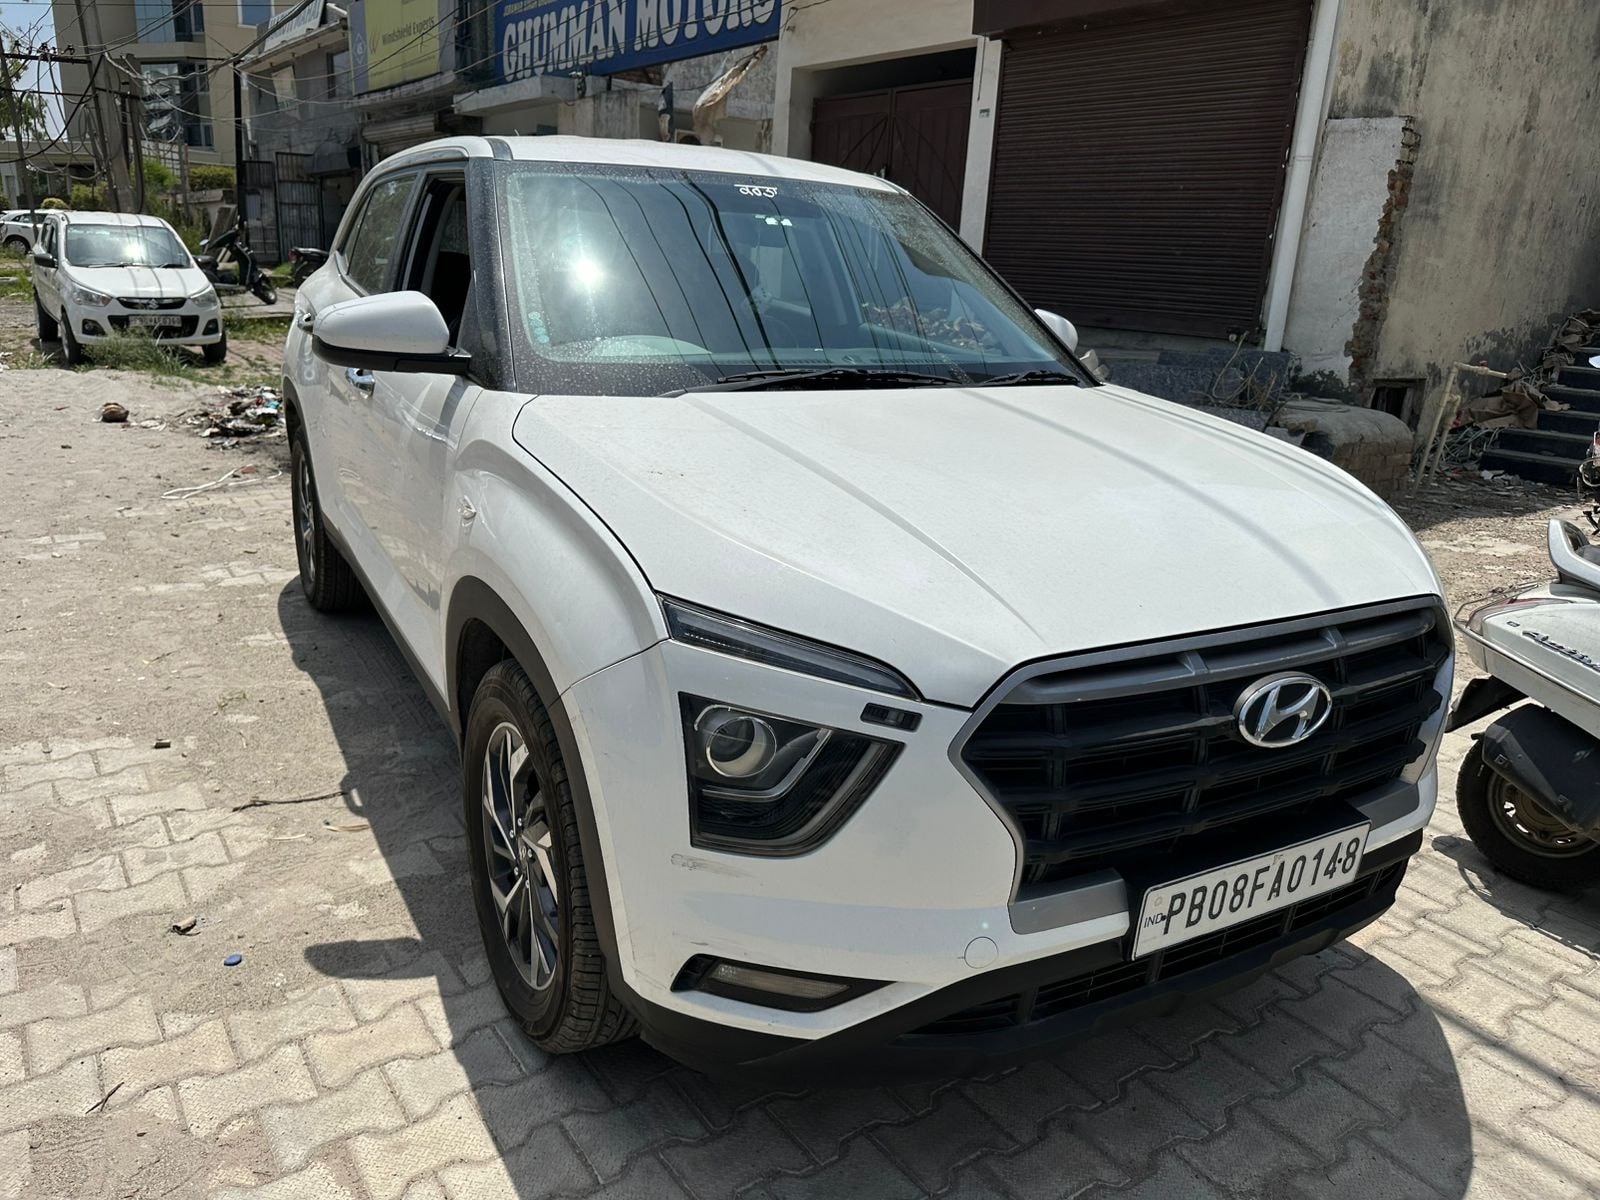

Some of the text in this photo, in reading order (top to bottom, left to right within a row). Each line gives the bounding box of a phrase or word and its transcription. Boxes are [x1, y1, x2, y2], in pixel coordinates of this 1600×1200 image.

[502, 0, 627, 83] GHUMMAN
[1143, 912, 1164, 929] IND
[1163, 837, 1361, 936] PB08FA0148
